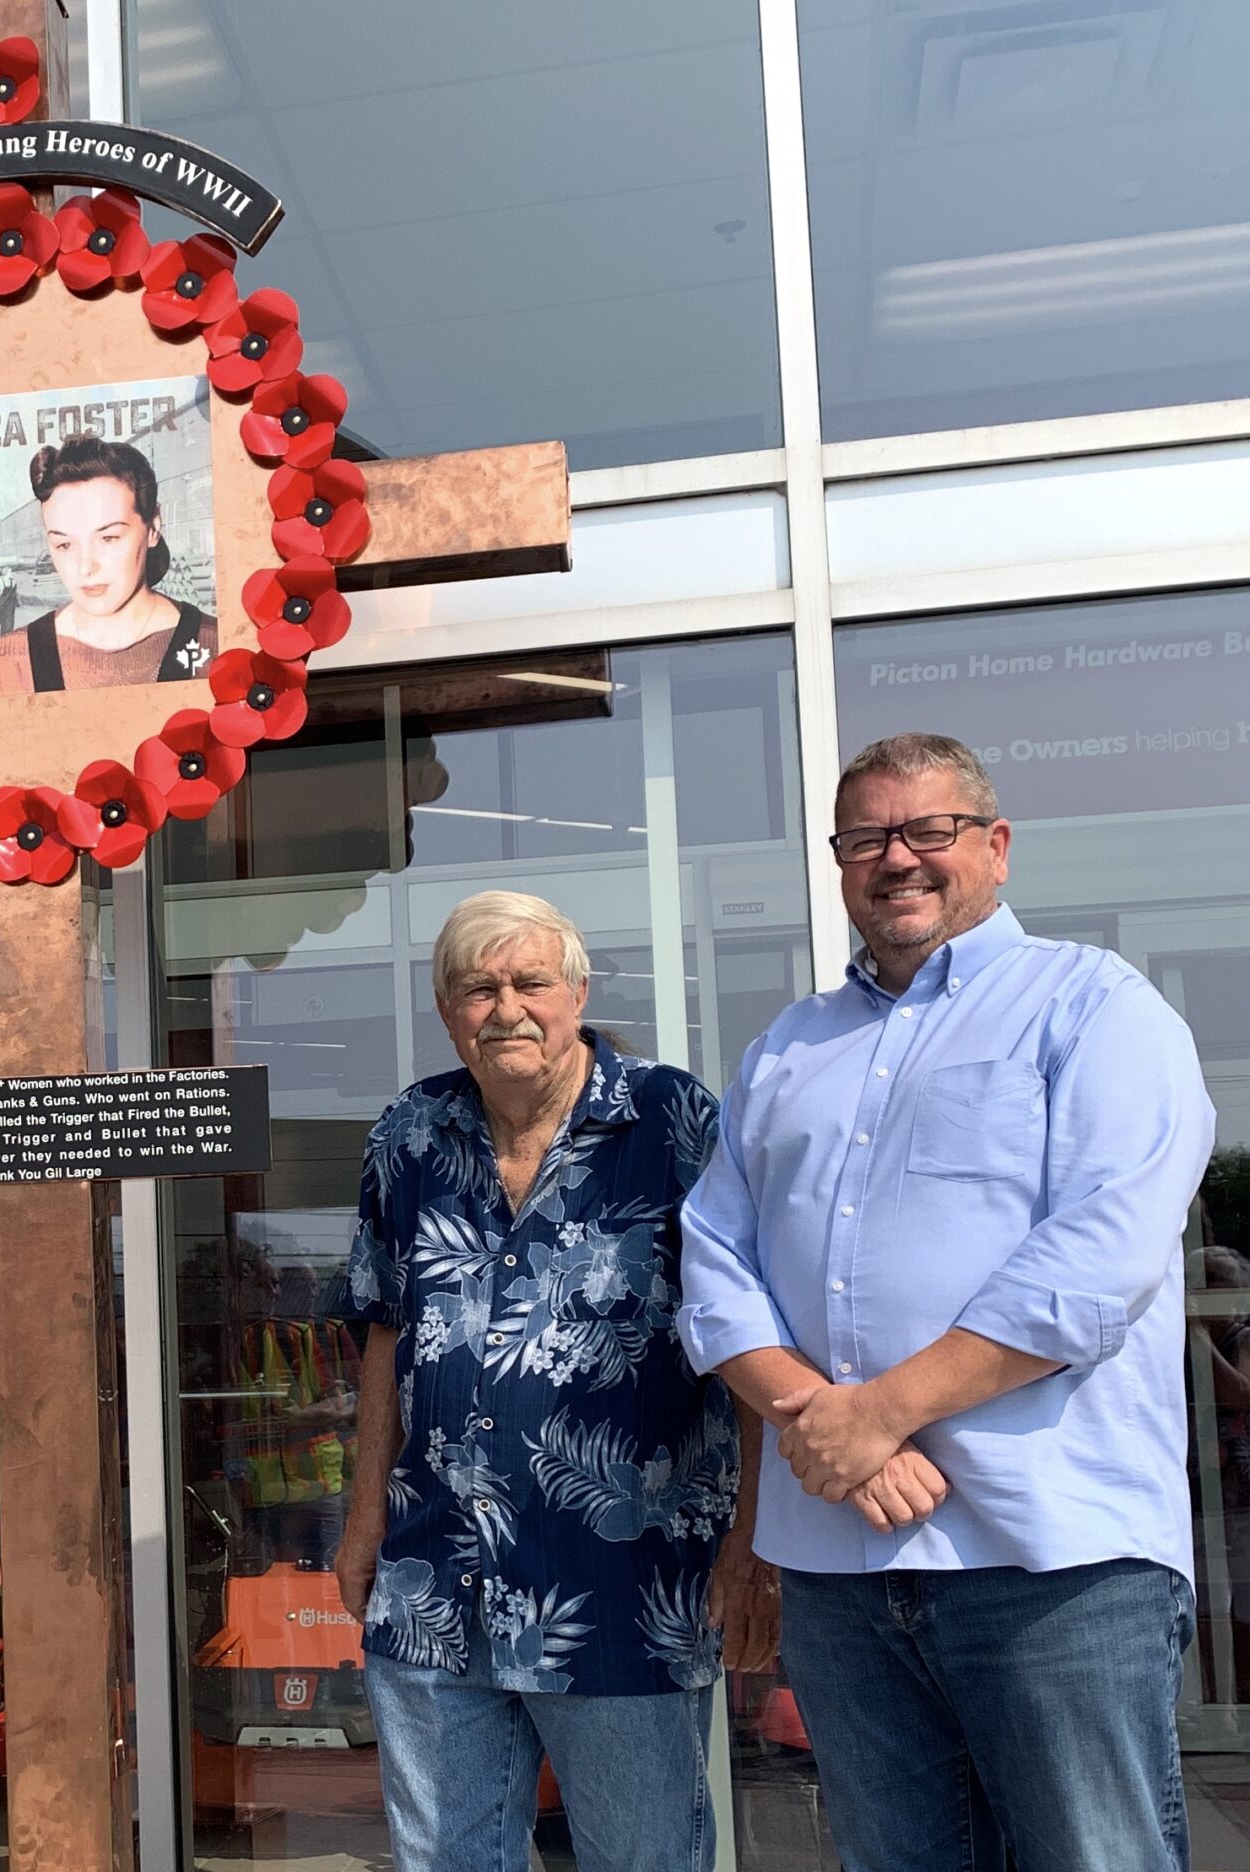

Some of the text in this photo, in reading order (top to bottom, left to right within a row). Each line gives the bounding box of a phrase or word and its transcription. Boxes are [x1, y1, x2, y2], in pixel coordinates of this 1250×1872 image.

[45, 130, 137, 162] Heroes
[142, 149, 172, 173] of
[177, 160, 254, 218] WWII
[37, 395, 178, 444] FOSTER
[870, 662, 956, 686] Picton
[968, 652, 1053, 678] Home
[1064, 638, 1212, 668] Hardware
[1010, 735, 1127, 762] Owners
[1136, 725, 1230, 754] helping
[8, 1079, 53, 1090] Women
[57, 1078, 81, 1088] who
[85, 1074, 128, 1086] worked
[132, 1074, 142, 1083] in
[146, 1072, 165, 1082] the
[170, 1069, 229, 1081] Factories.
[30, 1096, 38, 1107] &
[44, 1096, 80, 1106] Guns.
[85, 1094, 113, 1104] Who
[119, 1091, 149, 1102] went
[155, 1090, 171, 1100] on
[176, 1088, 230, 1099] Rations.
[26, 1114, 46, 1125] the
[50, 1113, 94, 1126] Trigger
[99, 1110, 123, 1122] that
[128, 1108, 160, 1120] Fired
[164, 1108, 184, 1118] the
[190, 1105, 231, 1117] Bullet,
[3, 1133, 56, 1146] Trigger
[66, 1130, 92, 1141] and
[102, 1127, 146, 1139] Bullet
[156, 1125, 186, 1136] that
[196, 1124, 232, 1137] gave
[22, 1150, 52, 1163] they
[60, 1147, 111, 1160] needed
[118, 1146, 132, 1157] to
[140, 1145, 164, 1156] win
[171, 1144, 194, 1154] the
[201, 1142, 232, 1152] War.
[18, 1169, 41, 1180] You
[45, 1167, 62, 1178] Gil
[66, 1166, 101, 1178] Large
